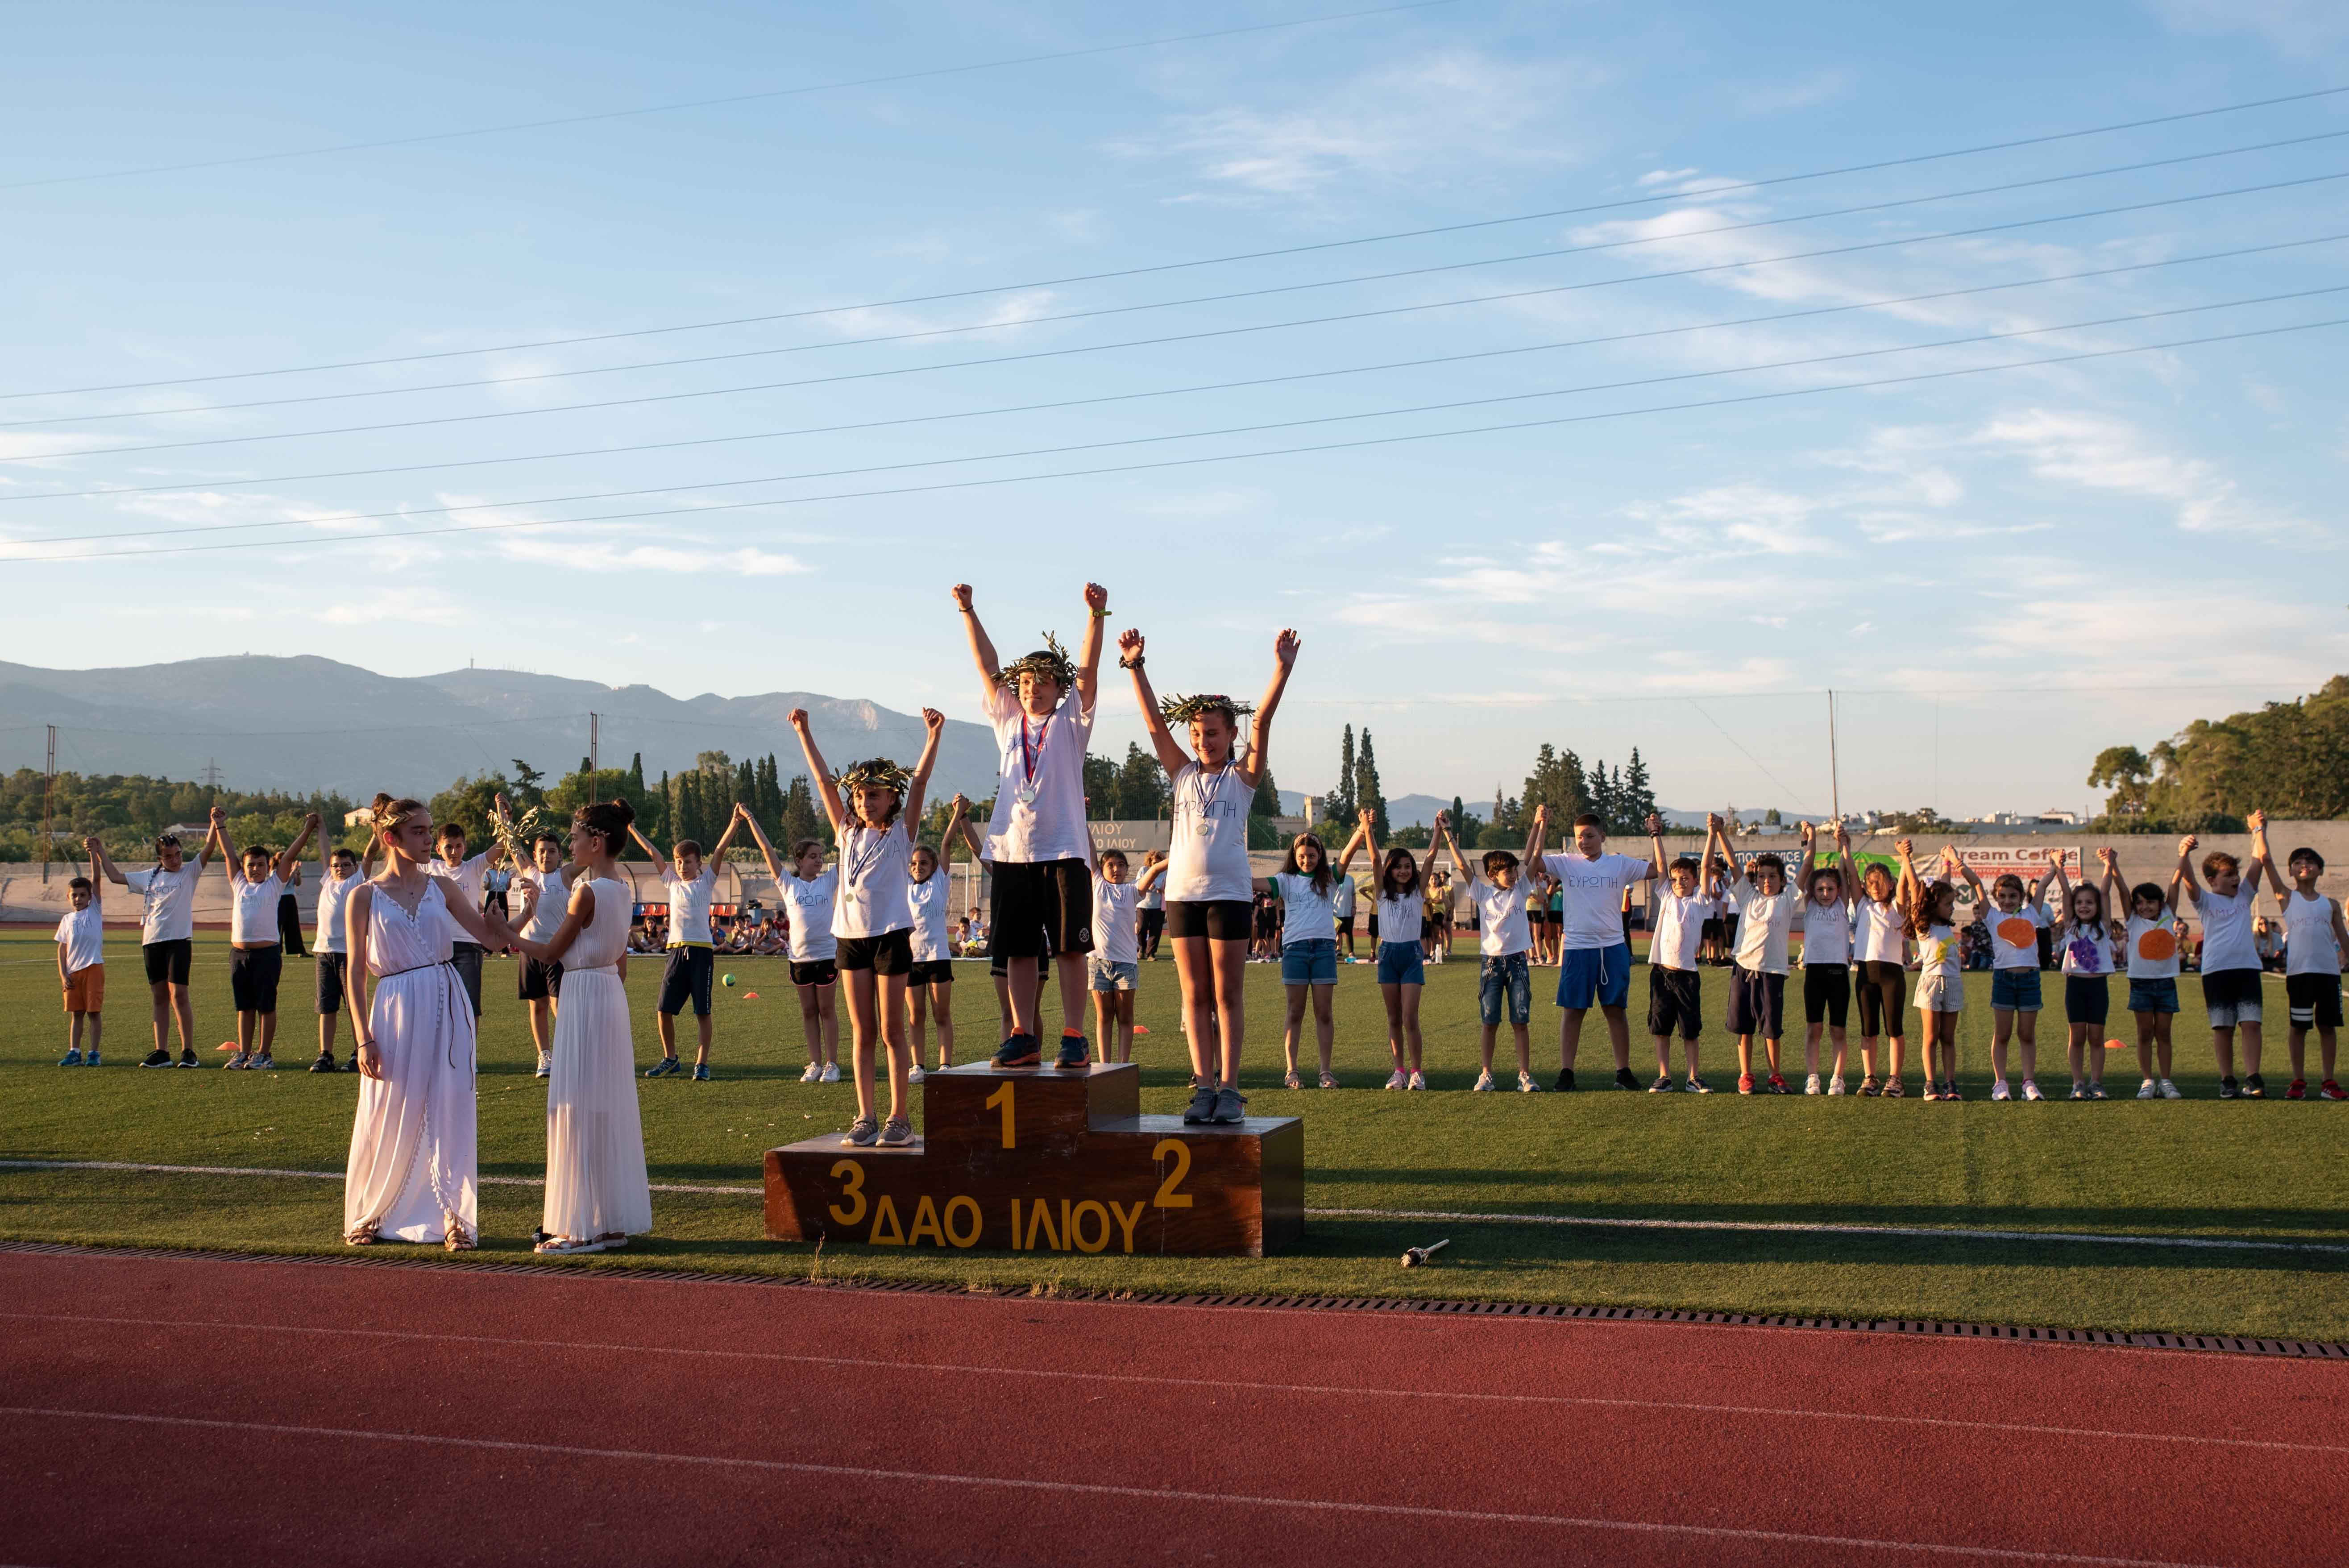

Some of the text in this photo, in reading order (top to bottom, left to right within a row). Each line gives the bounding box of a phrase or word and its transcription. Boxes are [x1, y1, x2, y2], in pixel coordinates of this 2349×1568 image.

[1960, 851, 2009, 860] ream
[986, 1081, 1015, 1148] 1
[829, 1159, 867, 1226] 3
[1152, 1138, 1193, 1207] 2
[868, 1195, 1146, 1254] ΔΑΟ ΙΛΙΟΥ
